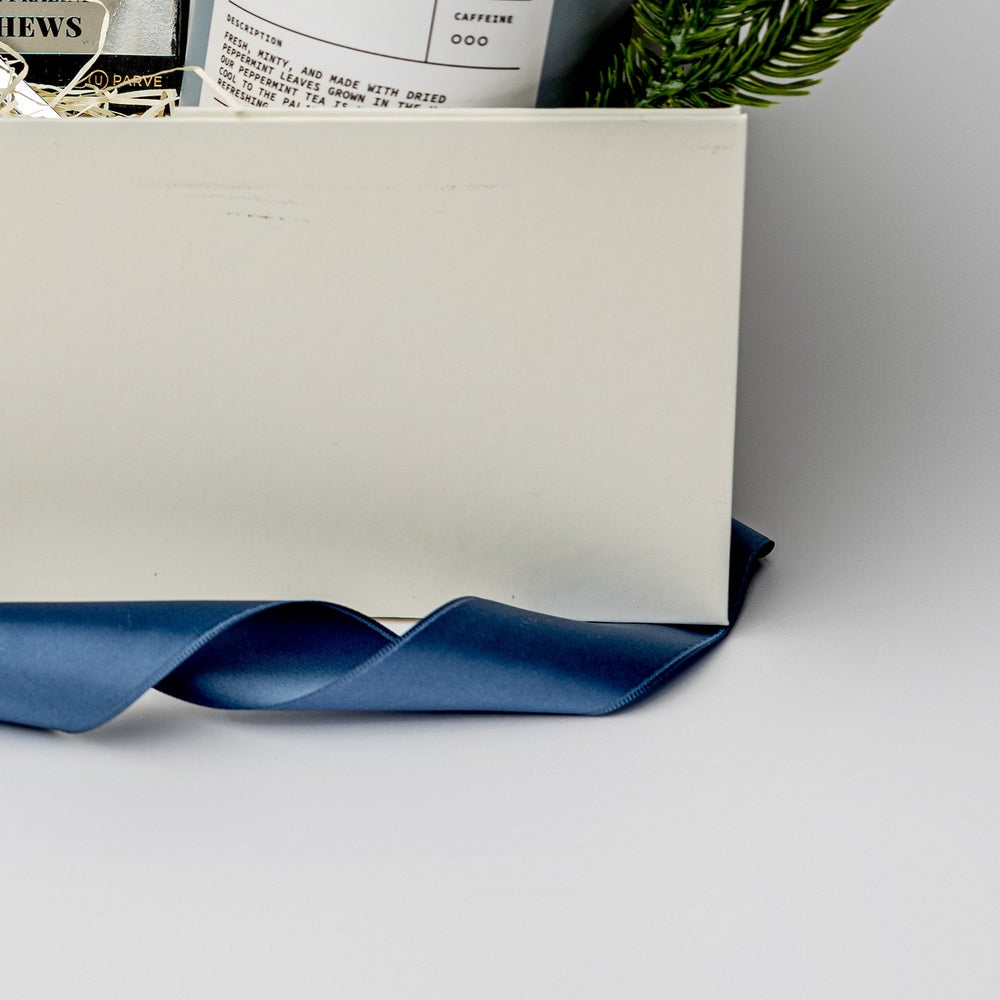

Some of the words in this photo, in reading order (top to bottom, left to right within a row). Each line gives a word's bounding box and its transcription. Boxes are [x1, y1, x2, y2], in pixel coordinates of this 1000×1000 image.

[226, 14, 283, 47] DESCRIPTION
[454, 12, 514, 24] CAFFEINE
[113, 74, 163, 88] PARVE
[219, 66, 237, 84] COOL
[242, 80, 253, 91] TO
[259, 87, 278, 102] THE
[220, 54, 235, 68] OUR
[238, 66, 299, 96] PEPPERMINT
[305, 92, 326, 105] TEA
[222, 43, 275, 75] PEPPERMINT
[280, 71, 320, 92] LEAVES
[328, 87, 366, 103] GROWN
[373, 97, 389, 108] IN
[224, 31, 251, 55] FRESH,
[257, 49, 293, 72] MINTY,
[300, 66, 323, 80] AND
[329, 74, 360, 89] MADE
[367, 83, 400, 97] WITH
[406, 91, 447, 104] DRIED
